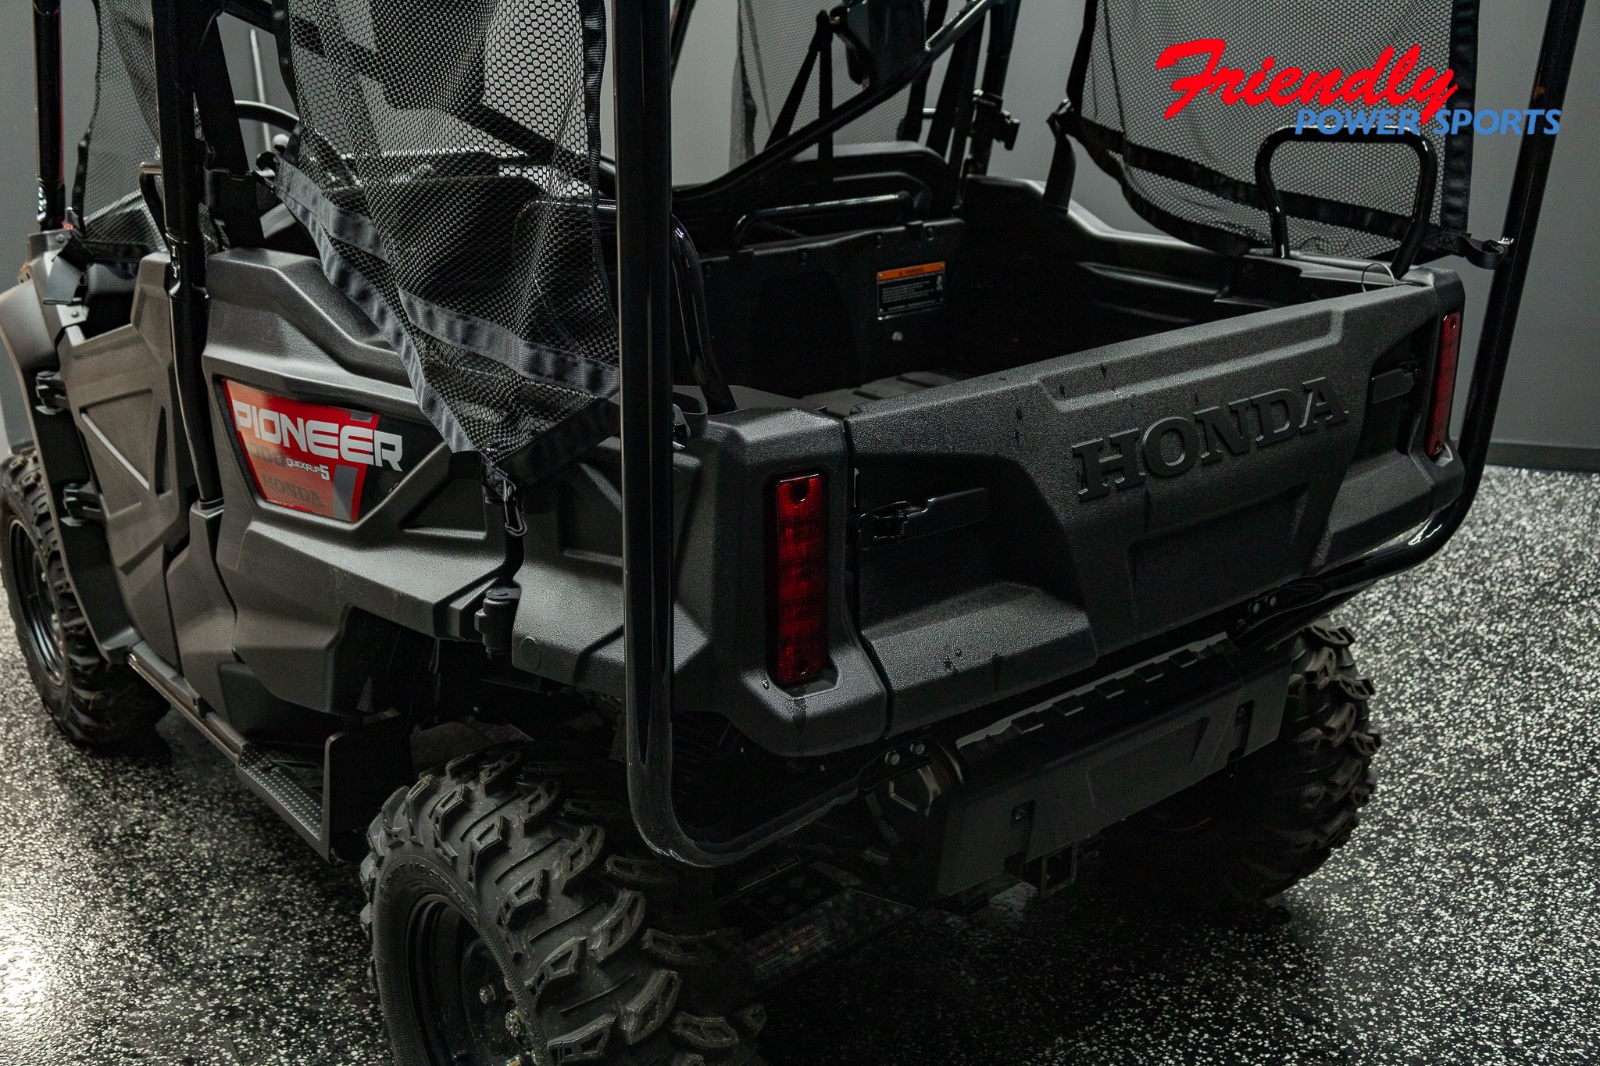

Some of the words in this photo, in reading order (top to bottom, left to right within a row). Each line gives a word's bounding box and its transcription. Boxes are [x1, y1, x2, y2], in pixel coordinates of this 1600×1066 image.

[231, 399, 403, 472] PIONEER
[1072, 377, 1350, 503] HONDA
[261, 473, 325, 508] HONDA
